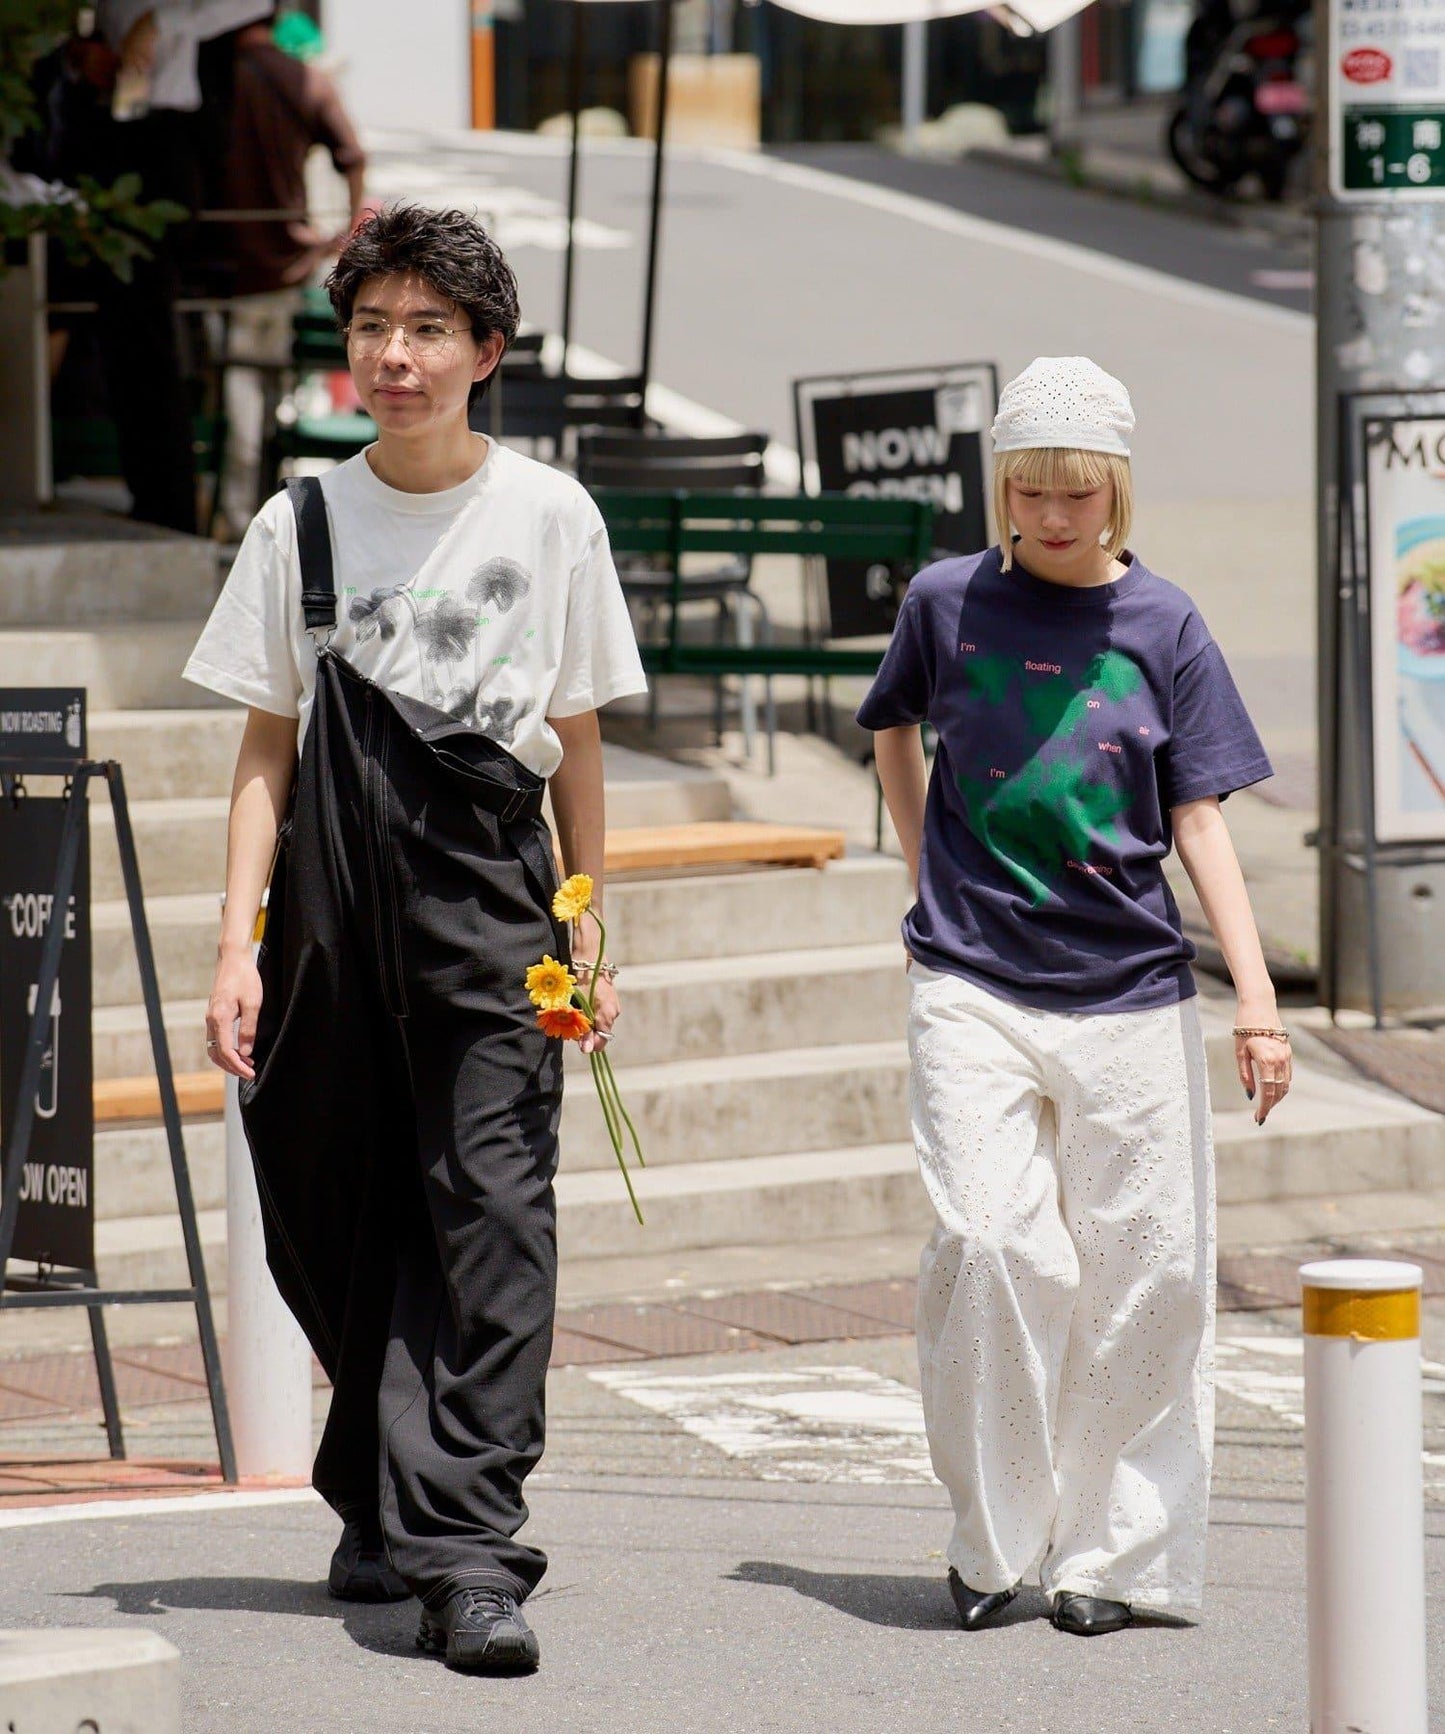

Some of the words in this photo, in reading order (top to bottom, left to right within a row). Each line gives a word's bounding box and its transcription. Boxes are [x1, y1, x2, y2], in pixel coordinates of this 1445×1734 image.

[1368, 153, 1432, 184] 1-6
[844, 427, 948, 471] NOW
[960, 642, 976, 652] I'm
[1025, 660, 1062, 674] floating
[1087, 700, 1100, 708] on
[0, 711, 21, 733] NOW
[22, 711, 63, 733] ROASTING
[1139, 726, 1150, 735] air
[1098, 742, 1122, 753] when
[990, 768, 1005, 778] I'm
[46, 1164, 87, 1207] OPEN
